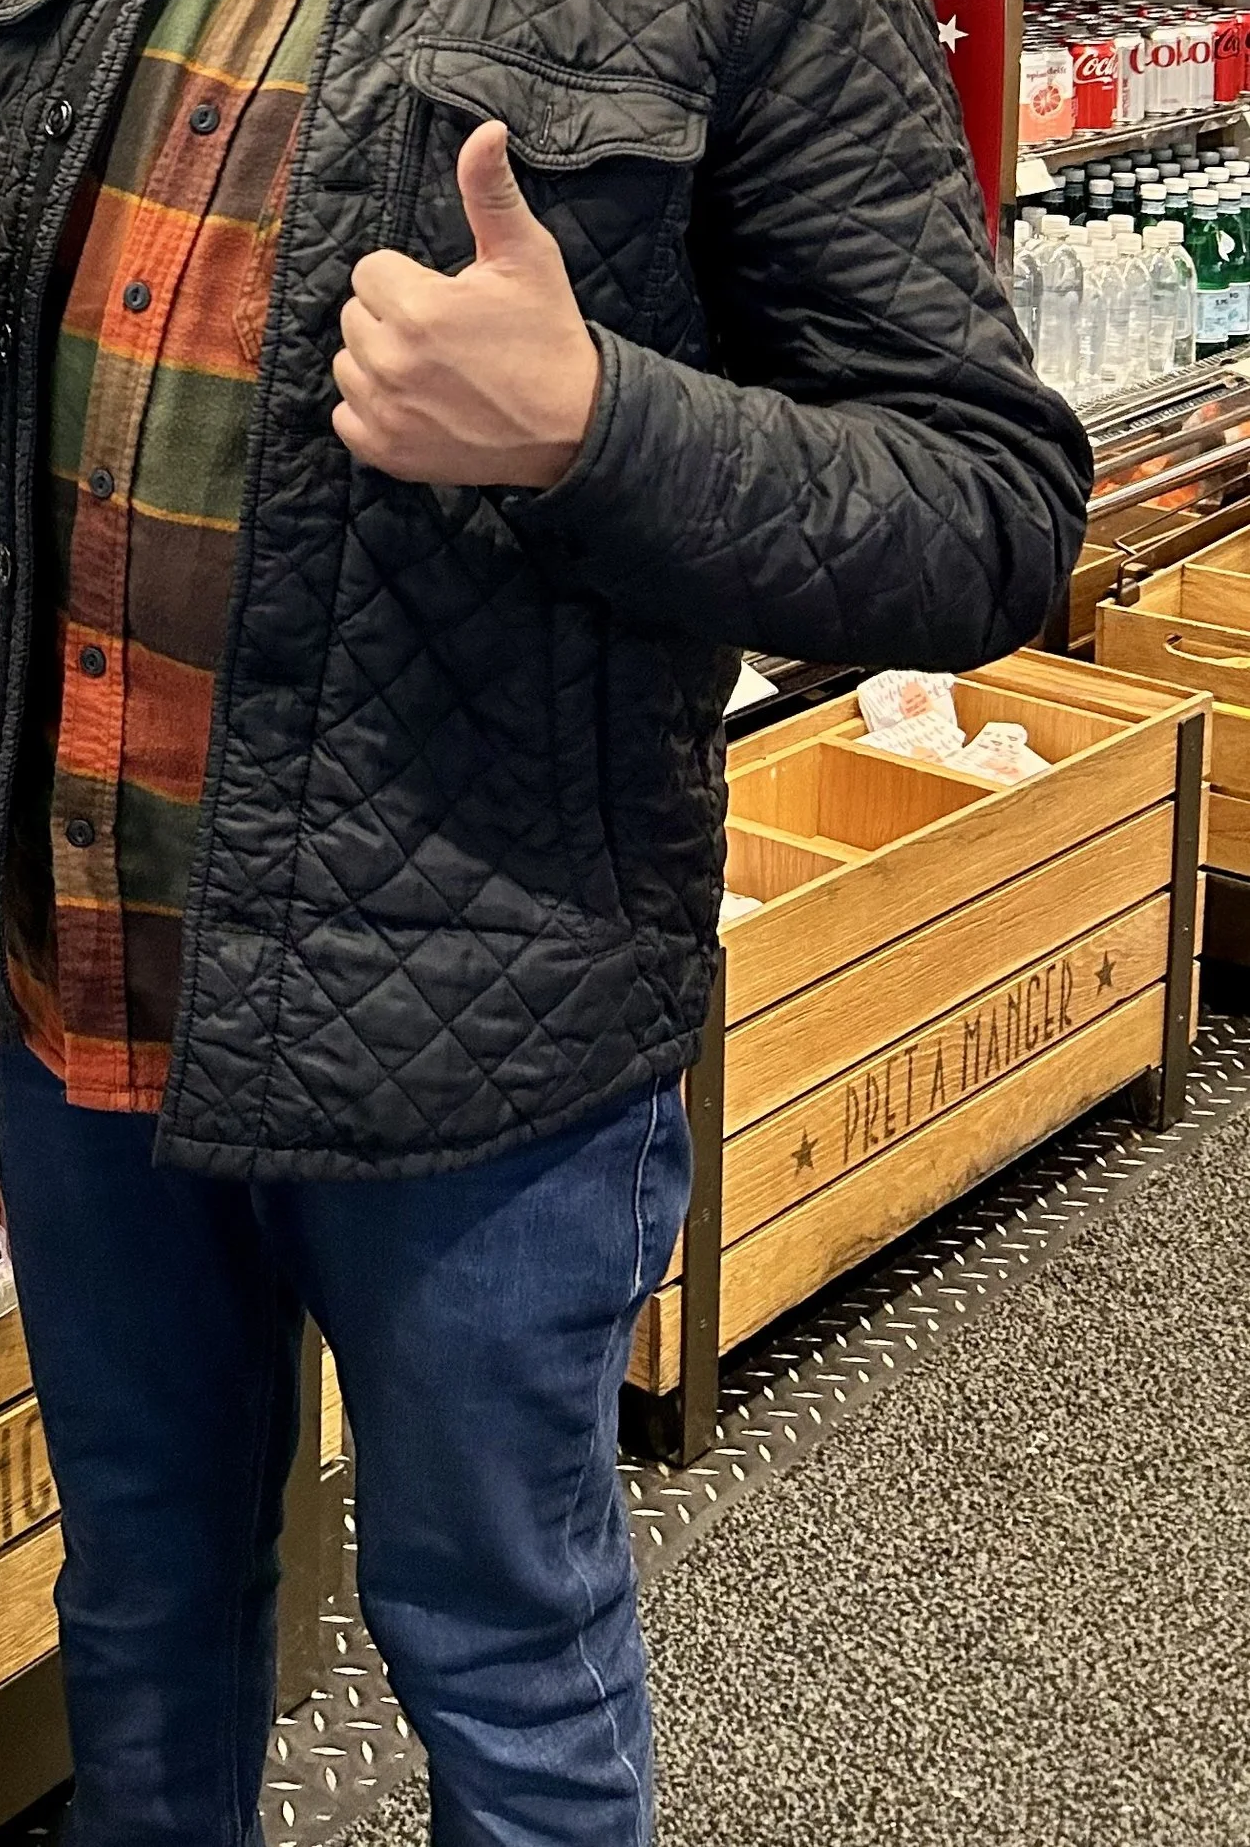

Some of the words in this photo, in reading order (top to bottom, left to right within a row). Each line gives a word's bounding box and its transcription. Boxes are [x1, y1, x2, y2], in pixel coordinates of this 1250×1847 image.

[843, 1040, 917, 1165] PRET
[928, 1047, 949, 1113] A
[959, 956, 1075, 1091] MANGER
